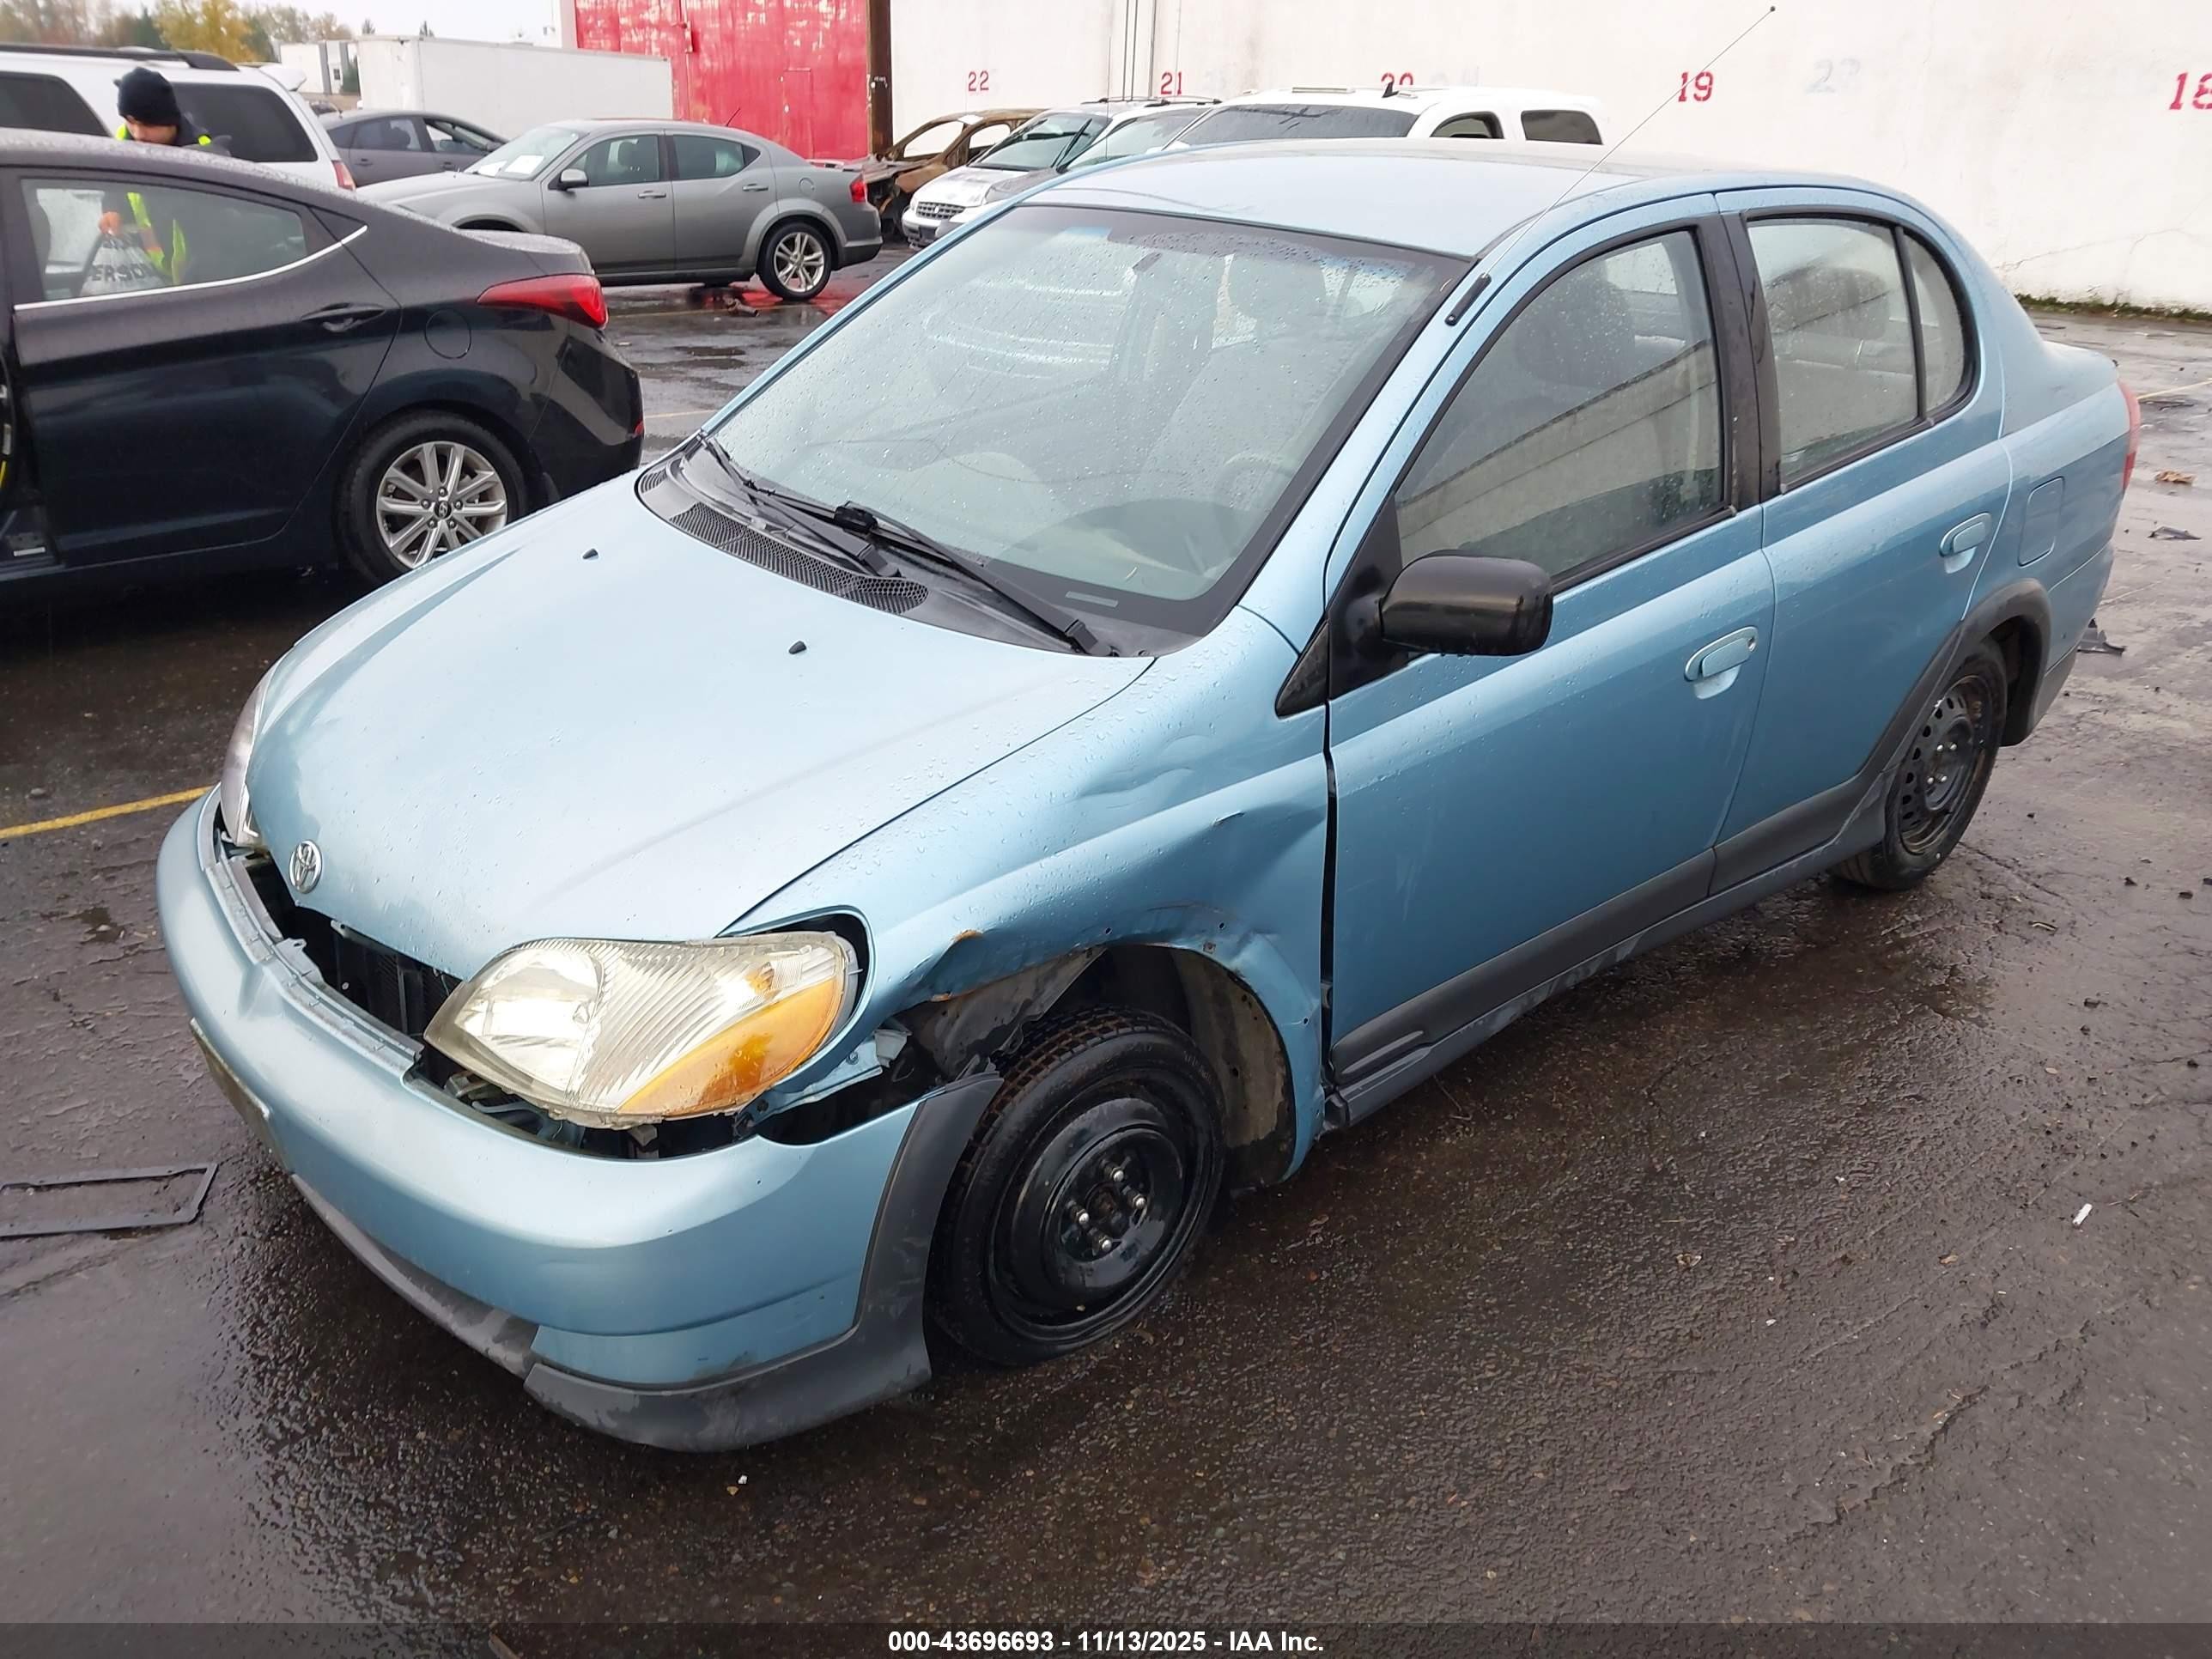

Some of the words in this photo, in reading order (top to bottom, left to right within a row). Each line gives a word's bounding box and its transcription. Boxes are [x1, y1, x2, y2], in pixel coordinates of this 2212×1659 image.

[968, 70, 989, 92] 22
[1160, 71, 1182, 95] 21
[1678, 71, 1714, 102] 19
